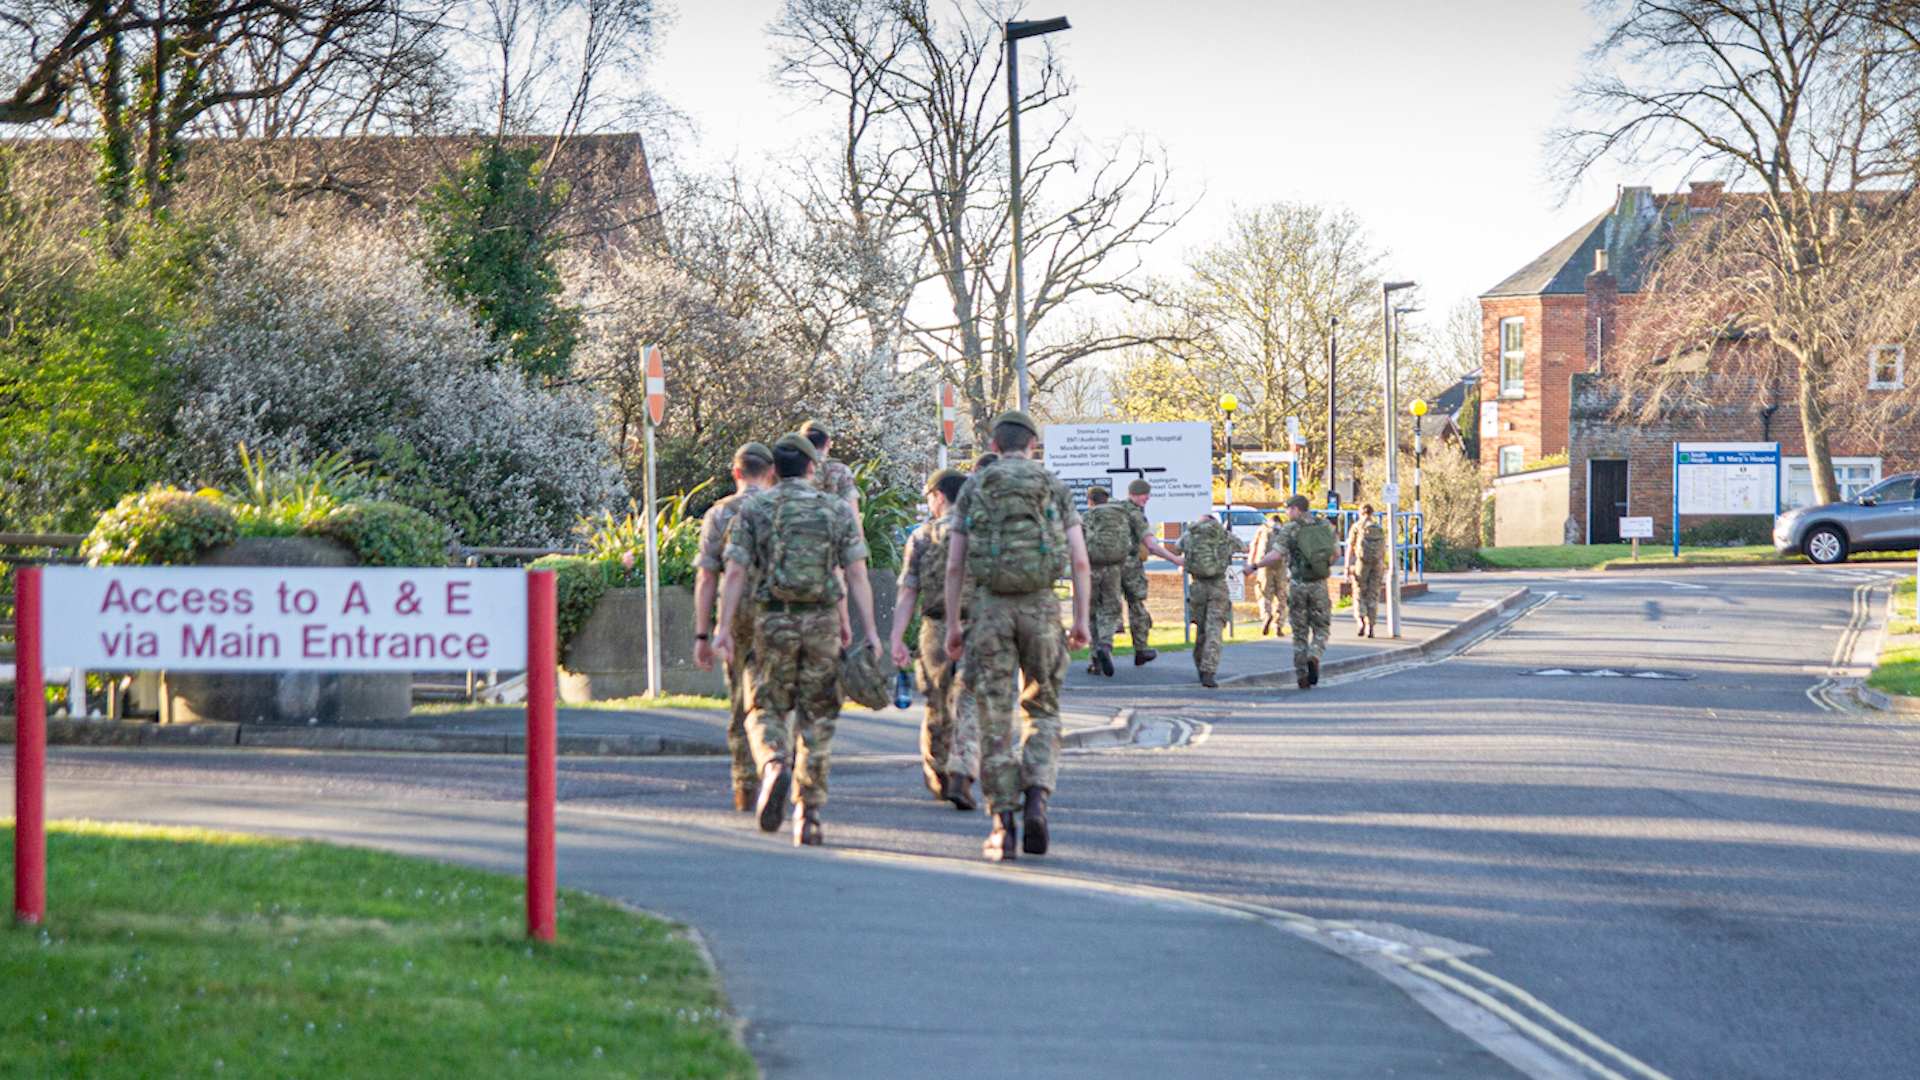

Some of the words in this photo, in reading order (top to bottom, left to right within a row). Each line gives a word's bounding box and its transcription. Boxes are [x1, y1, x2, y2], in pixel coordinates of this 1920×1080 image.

[1156, 434, 1182, 442] Hospital
[101, 580, 254, 615] Access
[278, 581, 318, 615] to
[342, 581, 370, 615] A
[395, 580, 421, 616] &
[447, 581, 471, 615] E
[101, 623, 158, 658] via
[182, 624, 280, 658] Main
[303, 624, 489, 659] Entrance
